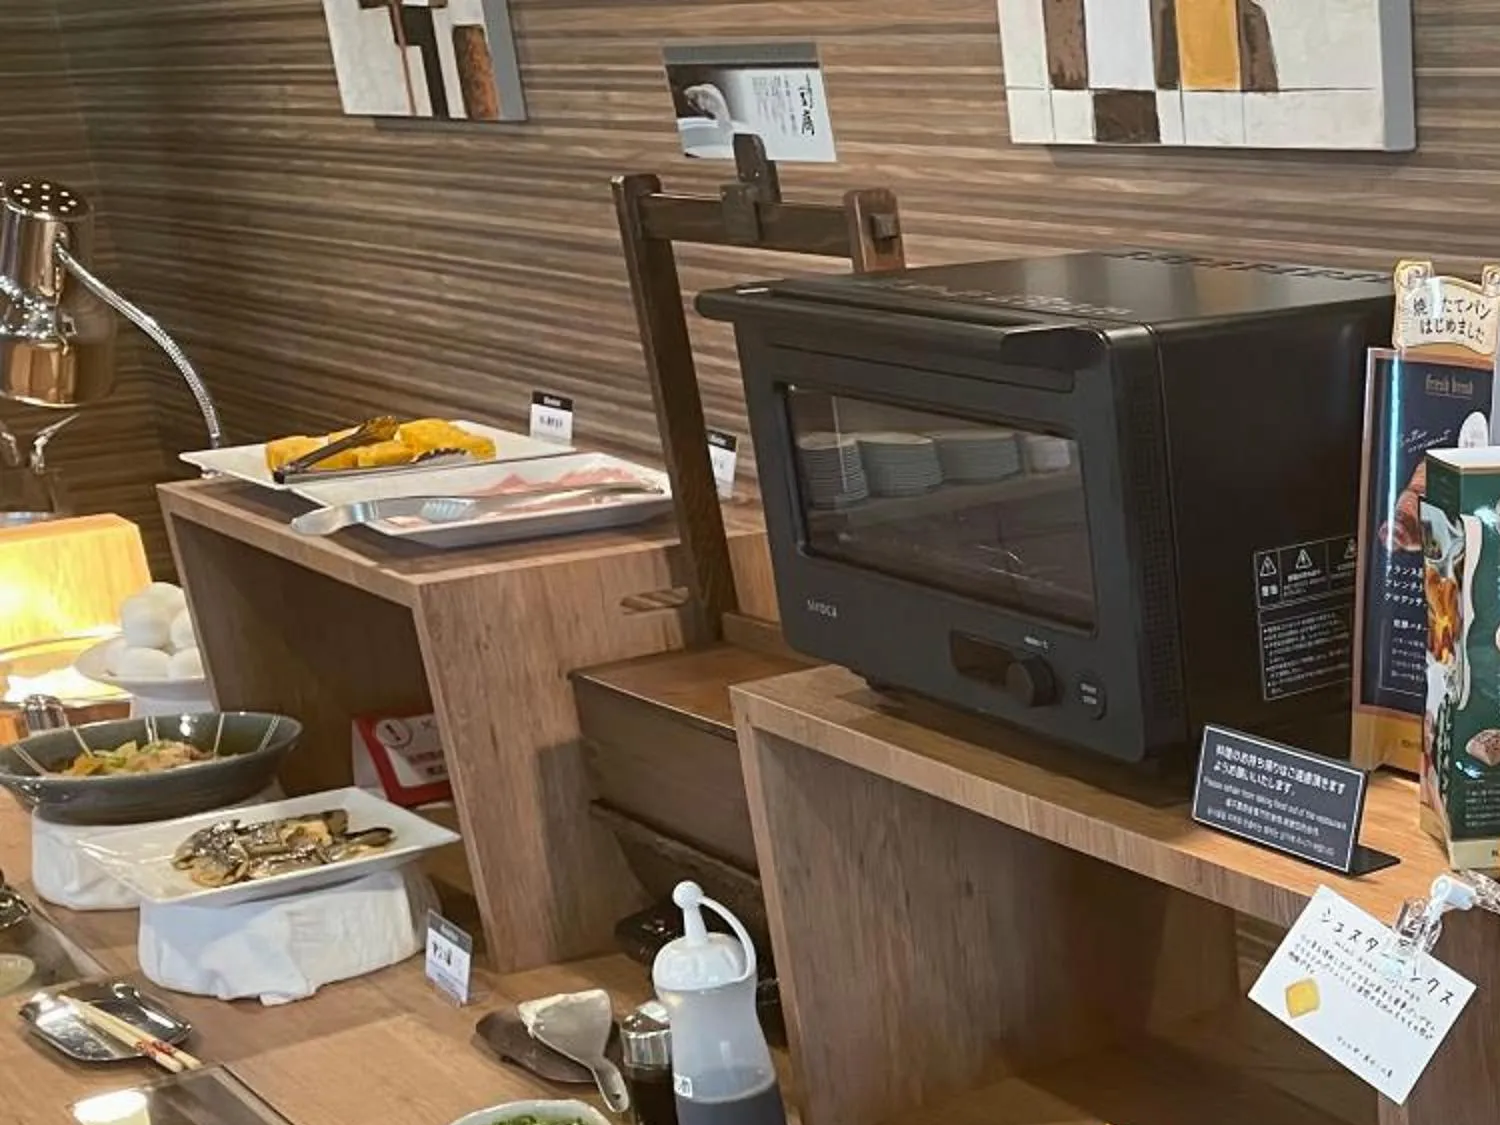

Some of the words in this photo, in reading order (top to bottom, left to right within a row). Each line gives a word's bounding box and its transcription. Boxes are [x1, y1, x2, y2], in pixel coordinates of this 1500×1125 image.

[1413, 297, 1491, 321] 焼たてパン
[1420, 318, 1485, 345] はじめました
